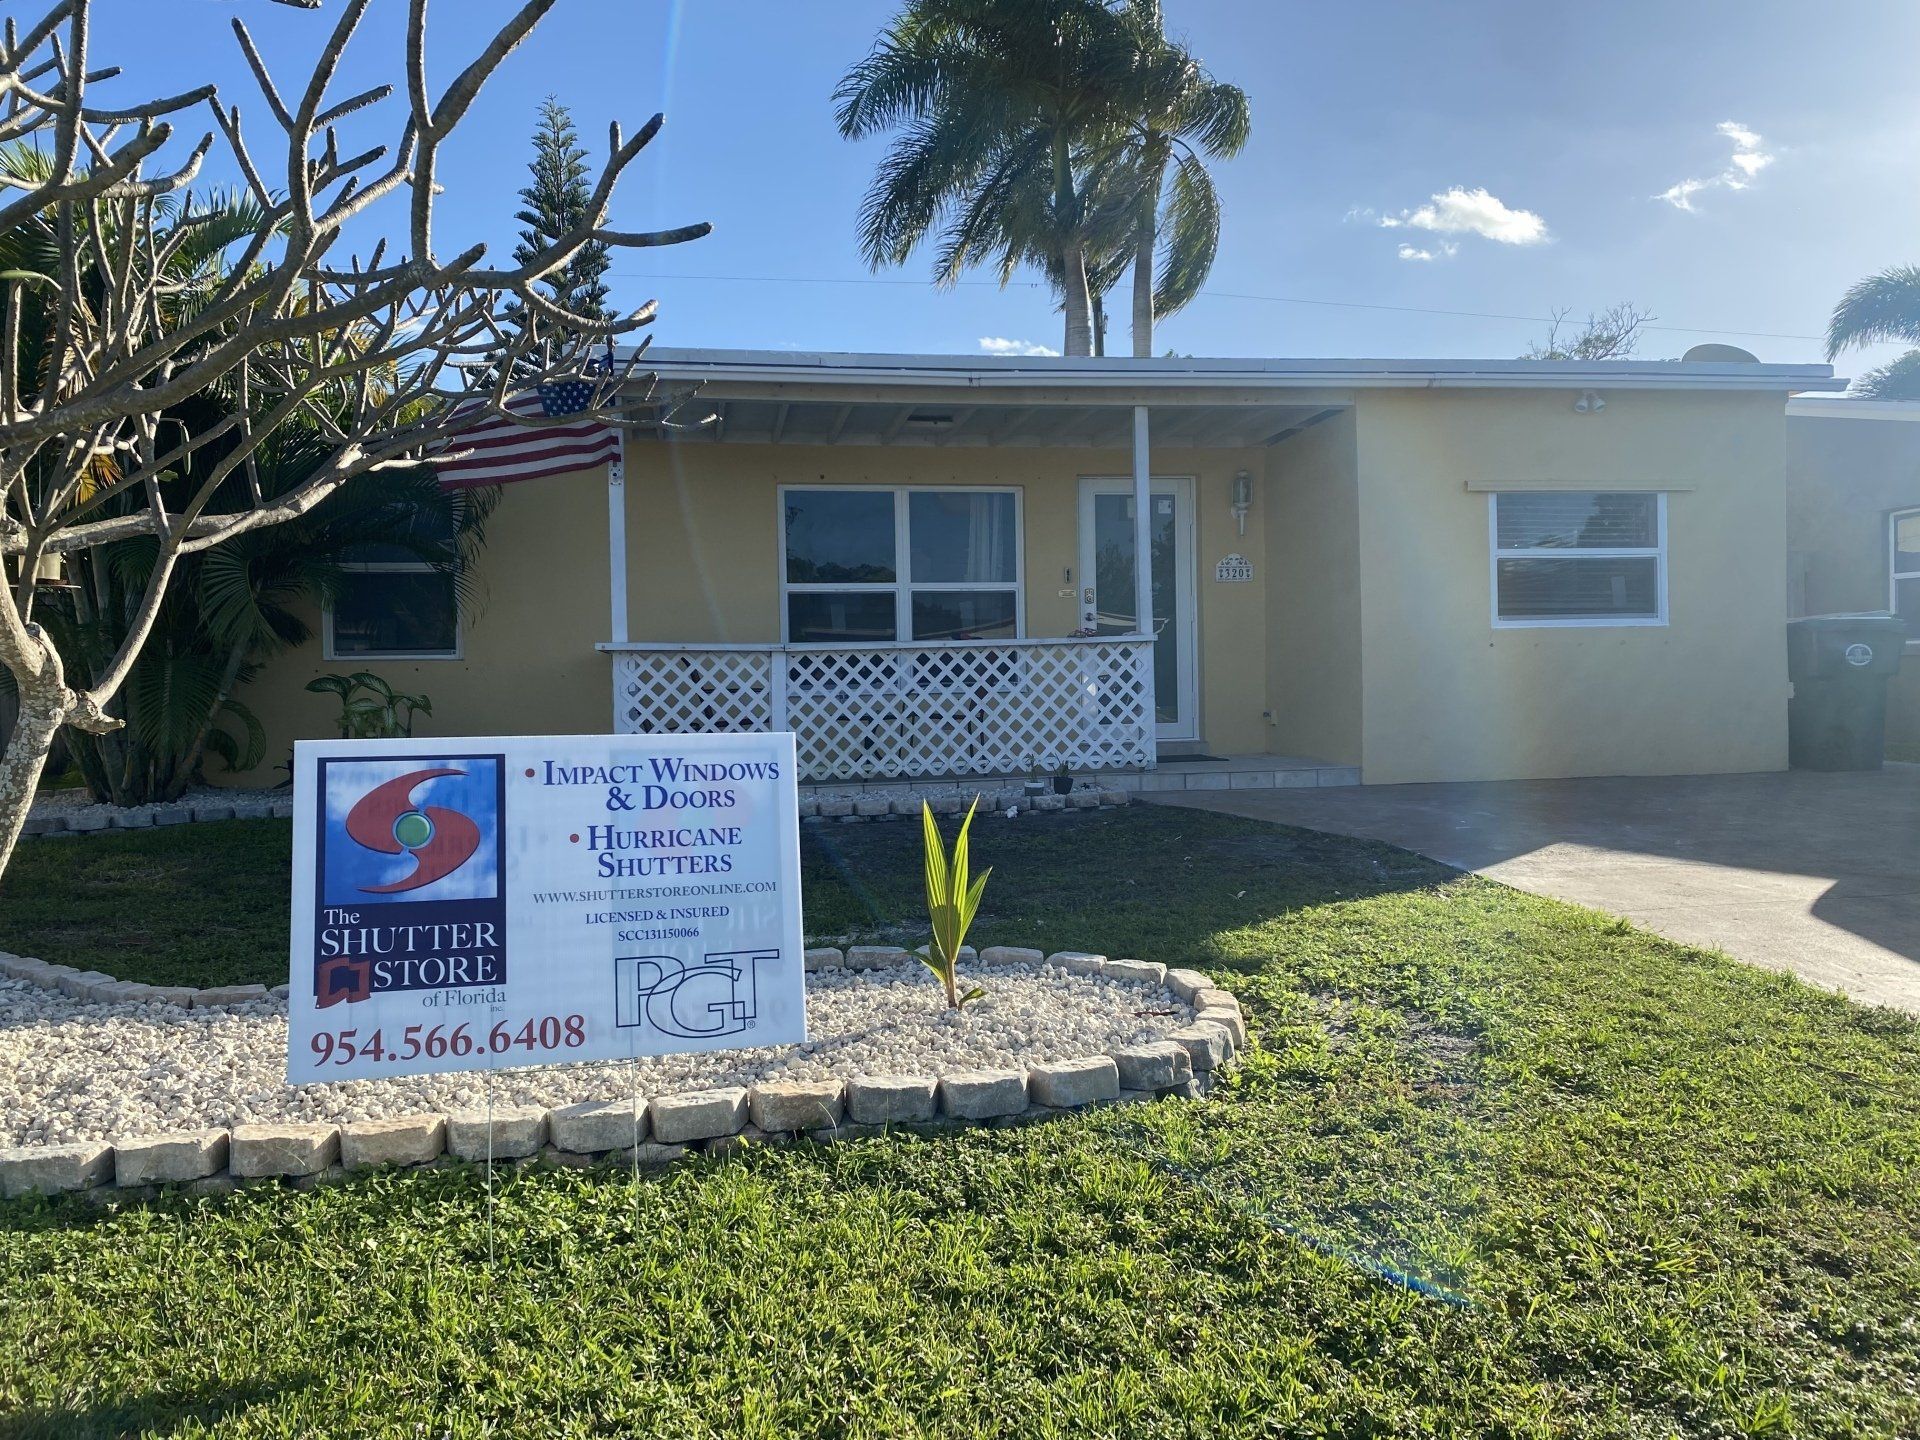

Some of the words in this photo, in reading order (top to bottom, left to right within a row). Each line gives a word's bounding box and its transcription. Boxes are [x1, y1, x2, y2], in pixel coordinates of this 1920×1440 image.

[543, 760, 643, 786] IMPACT
[648, 757, 780, 783] WINDOWS
[606, 786, 637, 812] &
[642, 785, 736, 811] DOORS
[587, 824, 743, 851] HURRICANE
[598, 852, 733, 878] SHUTTERS
[533, 881, 777, 904] WWW.SHUTTERSTOREONLINE.COM
[323, 908, 361, 925] The
[586, 909, 653, 925] LICENSED
[656, 909, 668, 920] &
[670, 905, 730, 920] INSURED
[320, 922, 500, 956] SHUTTER
[618, 927, 700, 942] SCC131150066
[373, 954, 498, 988] STORE
[422, 990, 444, 1008] of
[445, 988, 507, 1007] Florida
[310, 1014, 586, 1067] 954.566.6408
